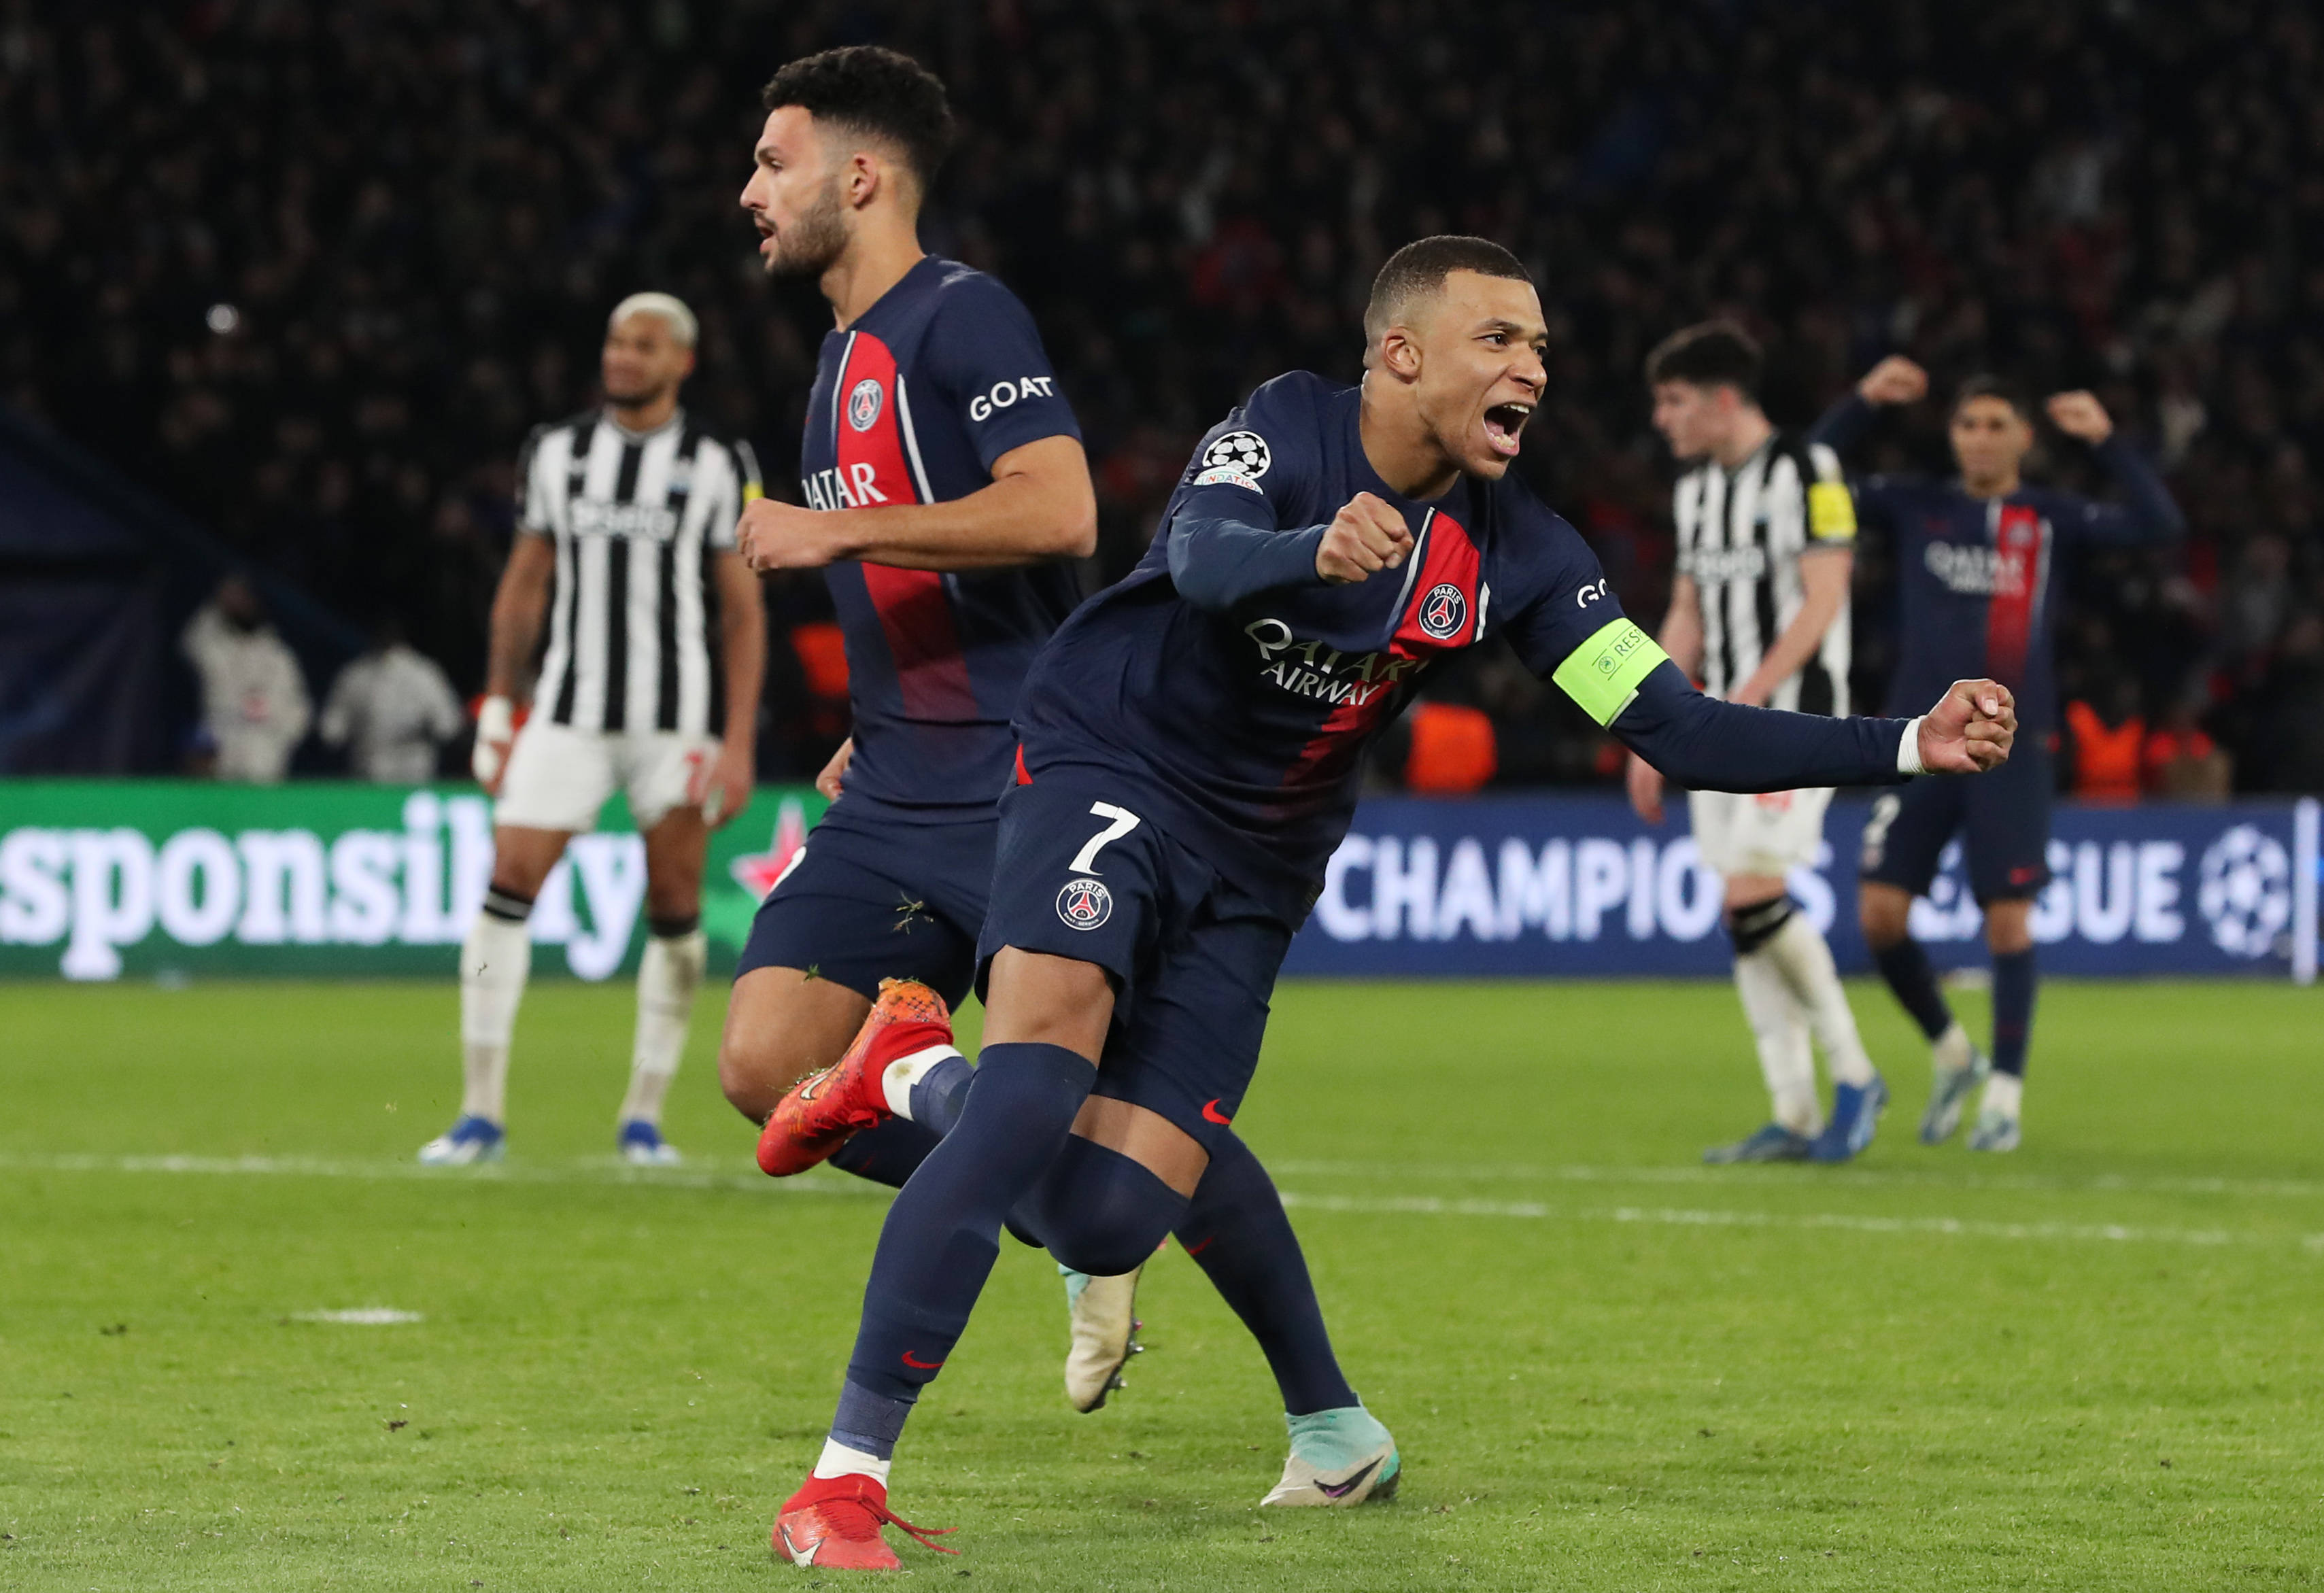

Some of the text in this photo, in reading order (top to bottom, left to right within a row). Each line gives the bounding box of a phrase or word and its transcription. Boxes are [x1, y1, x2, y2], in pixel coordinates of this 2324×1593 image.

[970, 376, 1054, 422] GOAT
[1433, 587, 1462, 604] PARIS
[1068, 801, 1141, 876] 7
[1068, 883, 1105, 897] PARIS
[1316, 833, 1834, 942] CHAMPIOS
